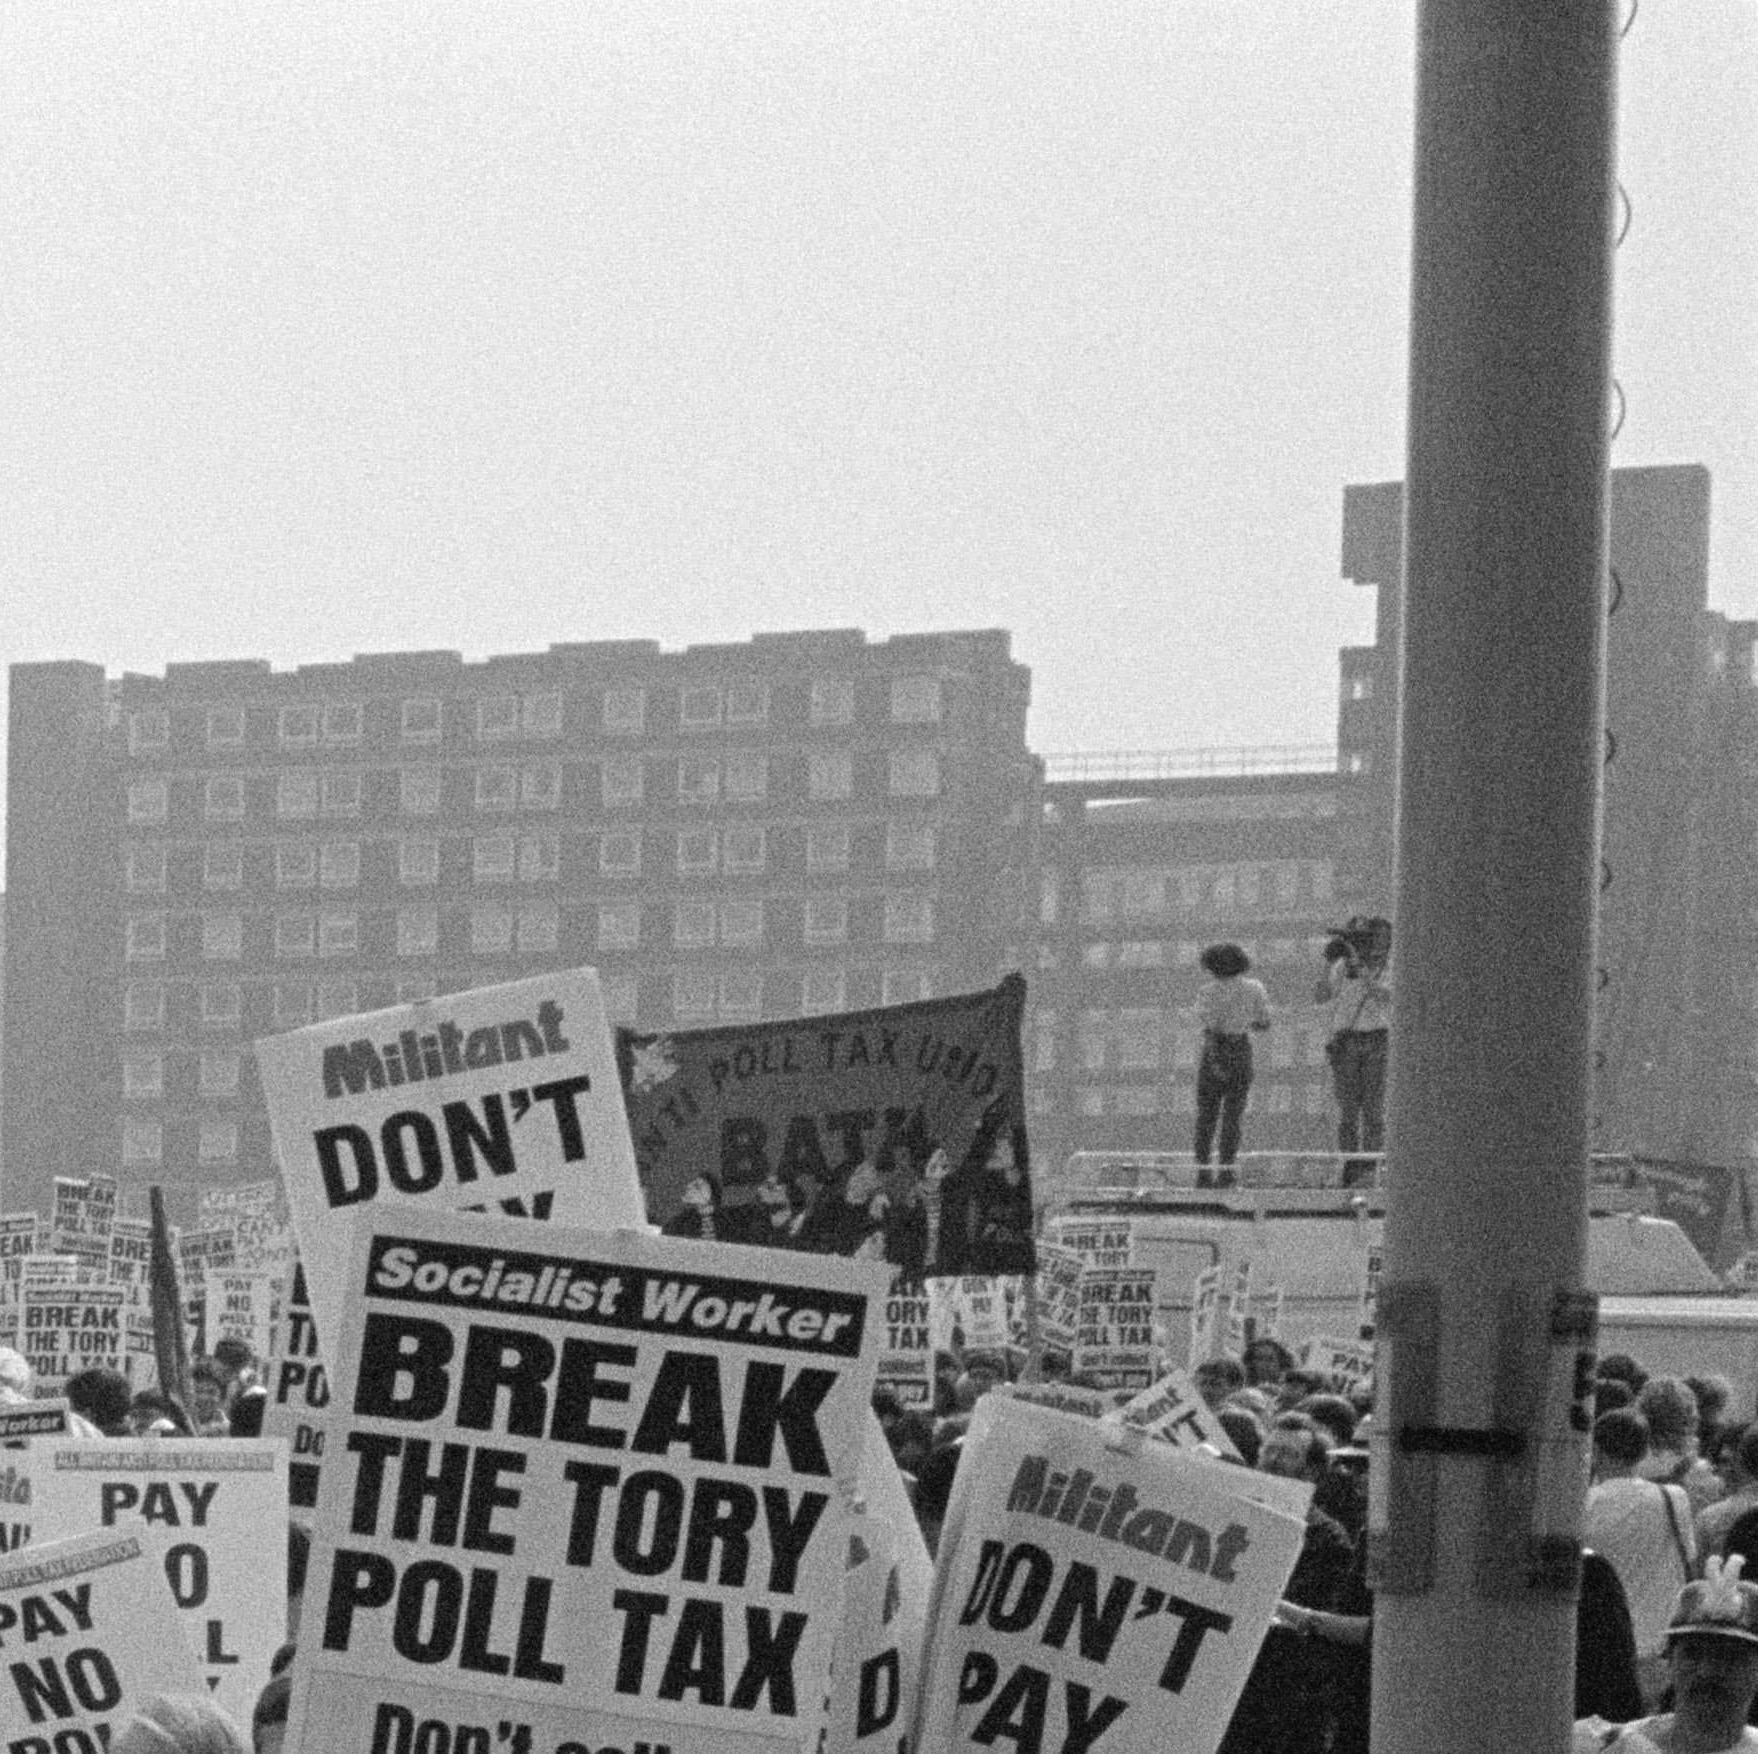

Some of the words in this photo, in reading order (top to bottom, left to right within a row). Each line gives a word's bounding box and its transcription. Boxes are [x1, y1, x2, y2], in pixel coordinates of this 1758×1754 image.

[321, 999, 571, 1101] Militant
[820, 1028, 904, 1070] TAX
[313, 1075, 592, 1208] DON'T
[25, 1304, 120, 1329] BREAK
[374, 1247, 625, 1318] Socialist
[641, 1277, 852, 1346] Worker
[1109, 1304, 1153, 1325] TORY
[24, 1331, 59, 1352] THE
[68, 1331, 120, 1354] TORY
[886, 1326, 930, 1350] TAX
[1117, 1326, 1152, 1348] TAX
[352, 1310, 841, 1478] BREAK
[101, 1481, 220, 1527] PAY
[347, 1430, 527, 1556] THE
[562, 1456, 831, 1596] TORY
[1006, 1453, 1251, 1585] Militant
[321, 1546, 567, 1687] POLL
[611, 1586, 809, 1718] TAX
[9, 1645, 123, 1724] NO
